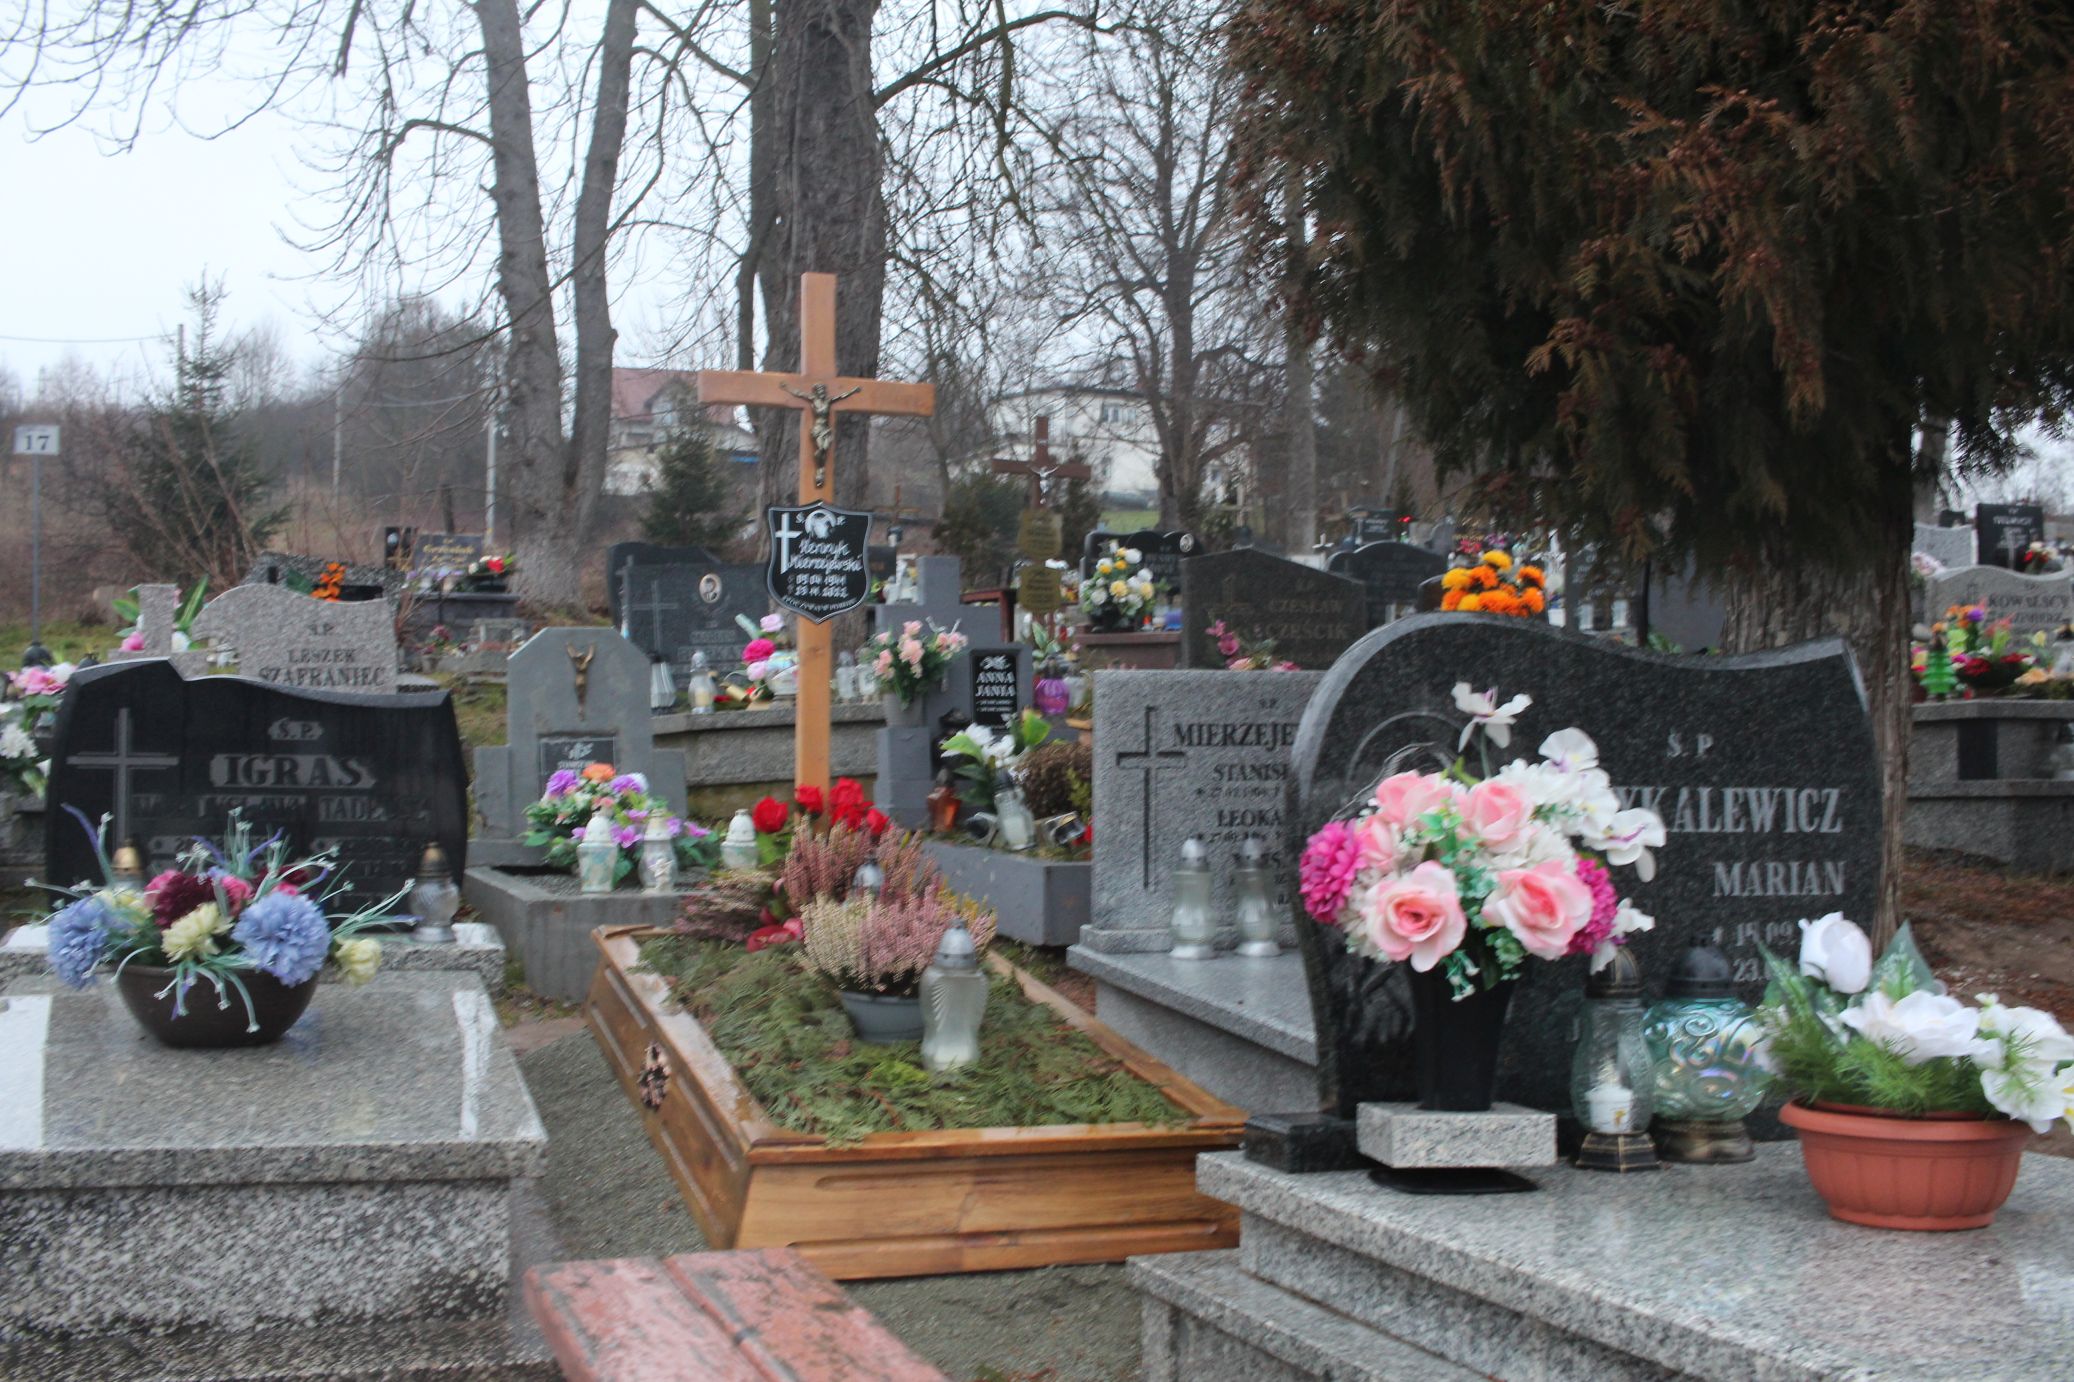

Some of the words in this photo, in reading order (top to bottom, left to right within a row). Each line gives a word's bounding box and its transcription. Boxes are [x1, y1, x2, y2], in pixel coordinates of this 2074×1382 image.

[25, 434, 50, 450] 17
[288, 649, 355, 664] LESZEK
[258, 666, 387, 687] SZAFRANIEC
[976, 671, 1016, 683] ANNA
[1173, 722, 1299, 751] MIERZEJE
[223, 754, 365, 787] IGRAS
[1712, 861, 1848, 897] MARIAN
